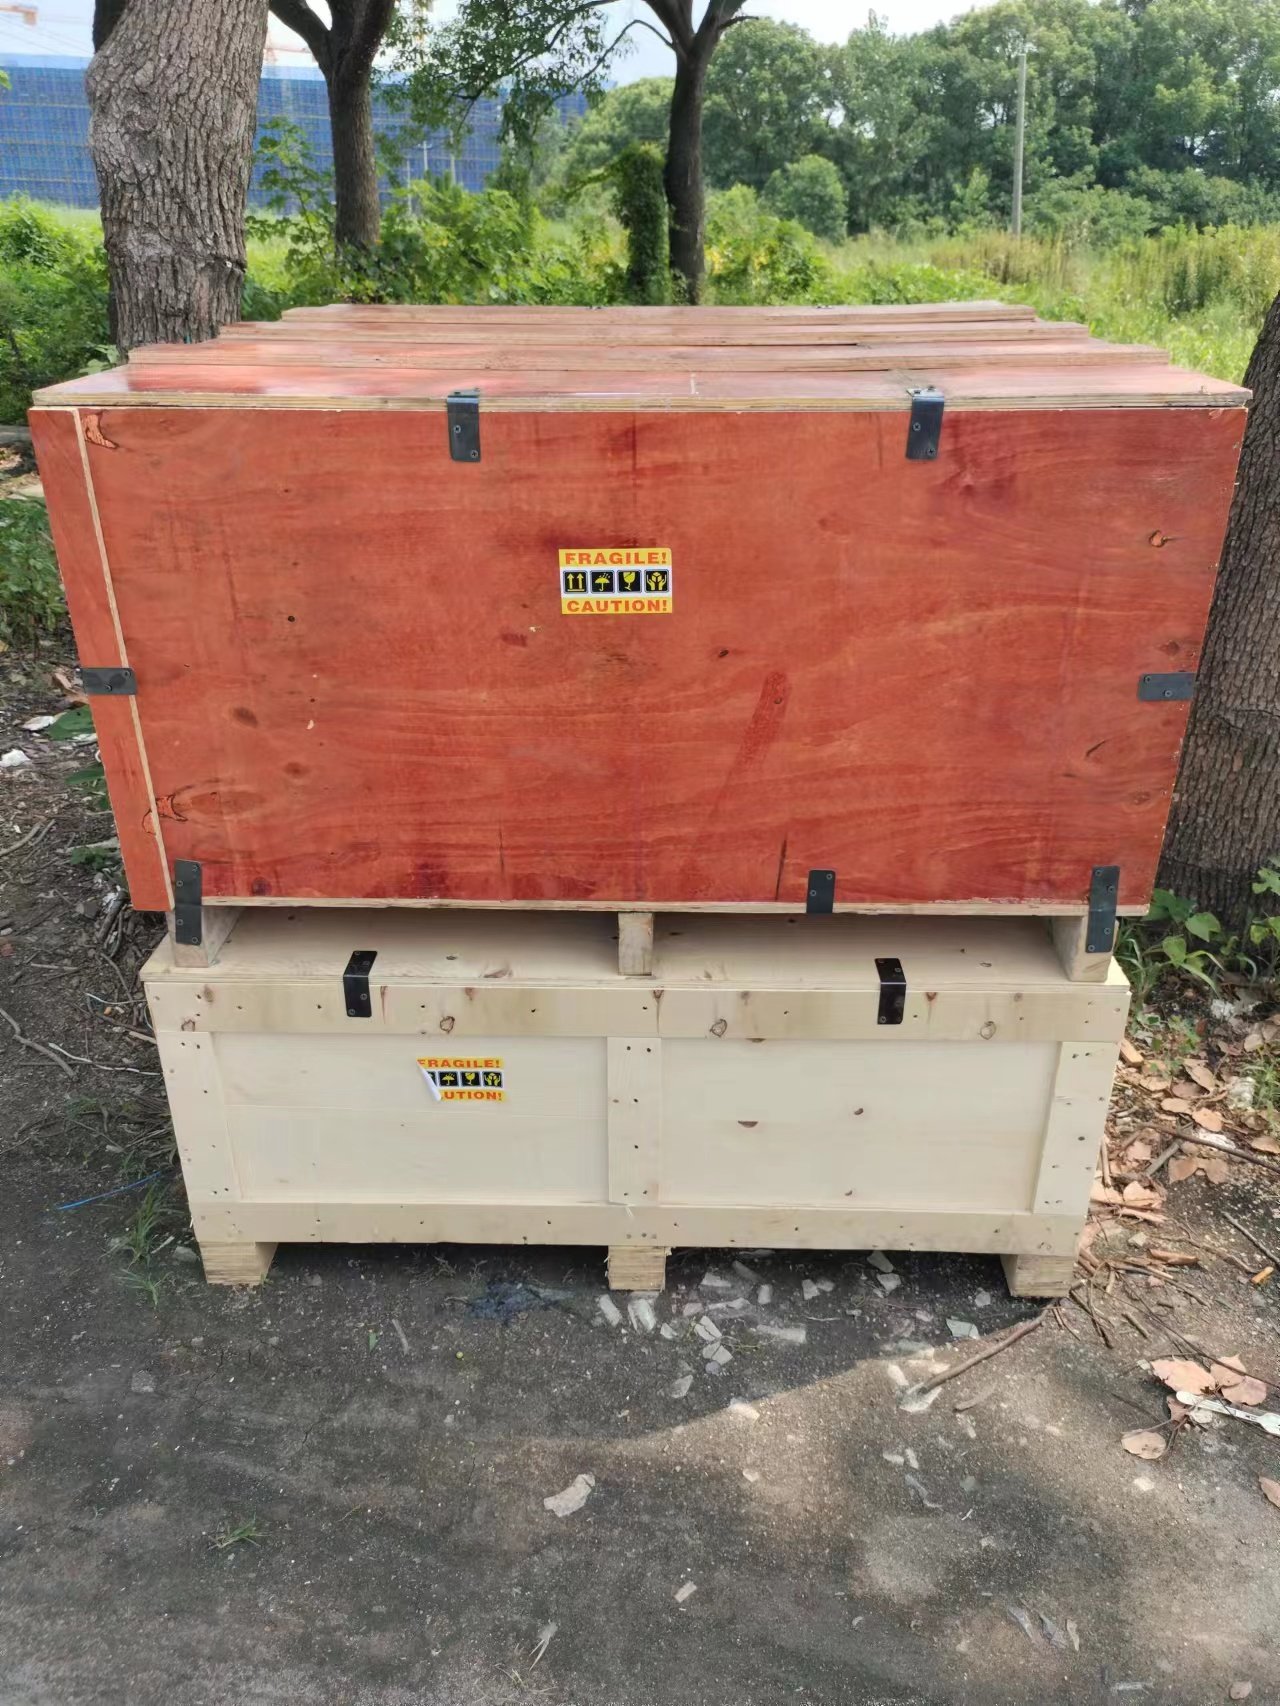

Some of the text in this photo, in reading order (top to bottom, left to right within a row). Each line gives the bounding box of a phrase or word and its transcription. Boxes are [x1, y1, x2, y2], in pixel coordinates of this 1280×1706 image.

[565, 552, 667, 565] FRAGILE!
[567, 600, 668, 613] CAUTION!
[441, 1091, 502, 1101] UTION!
